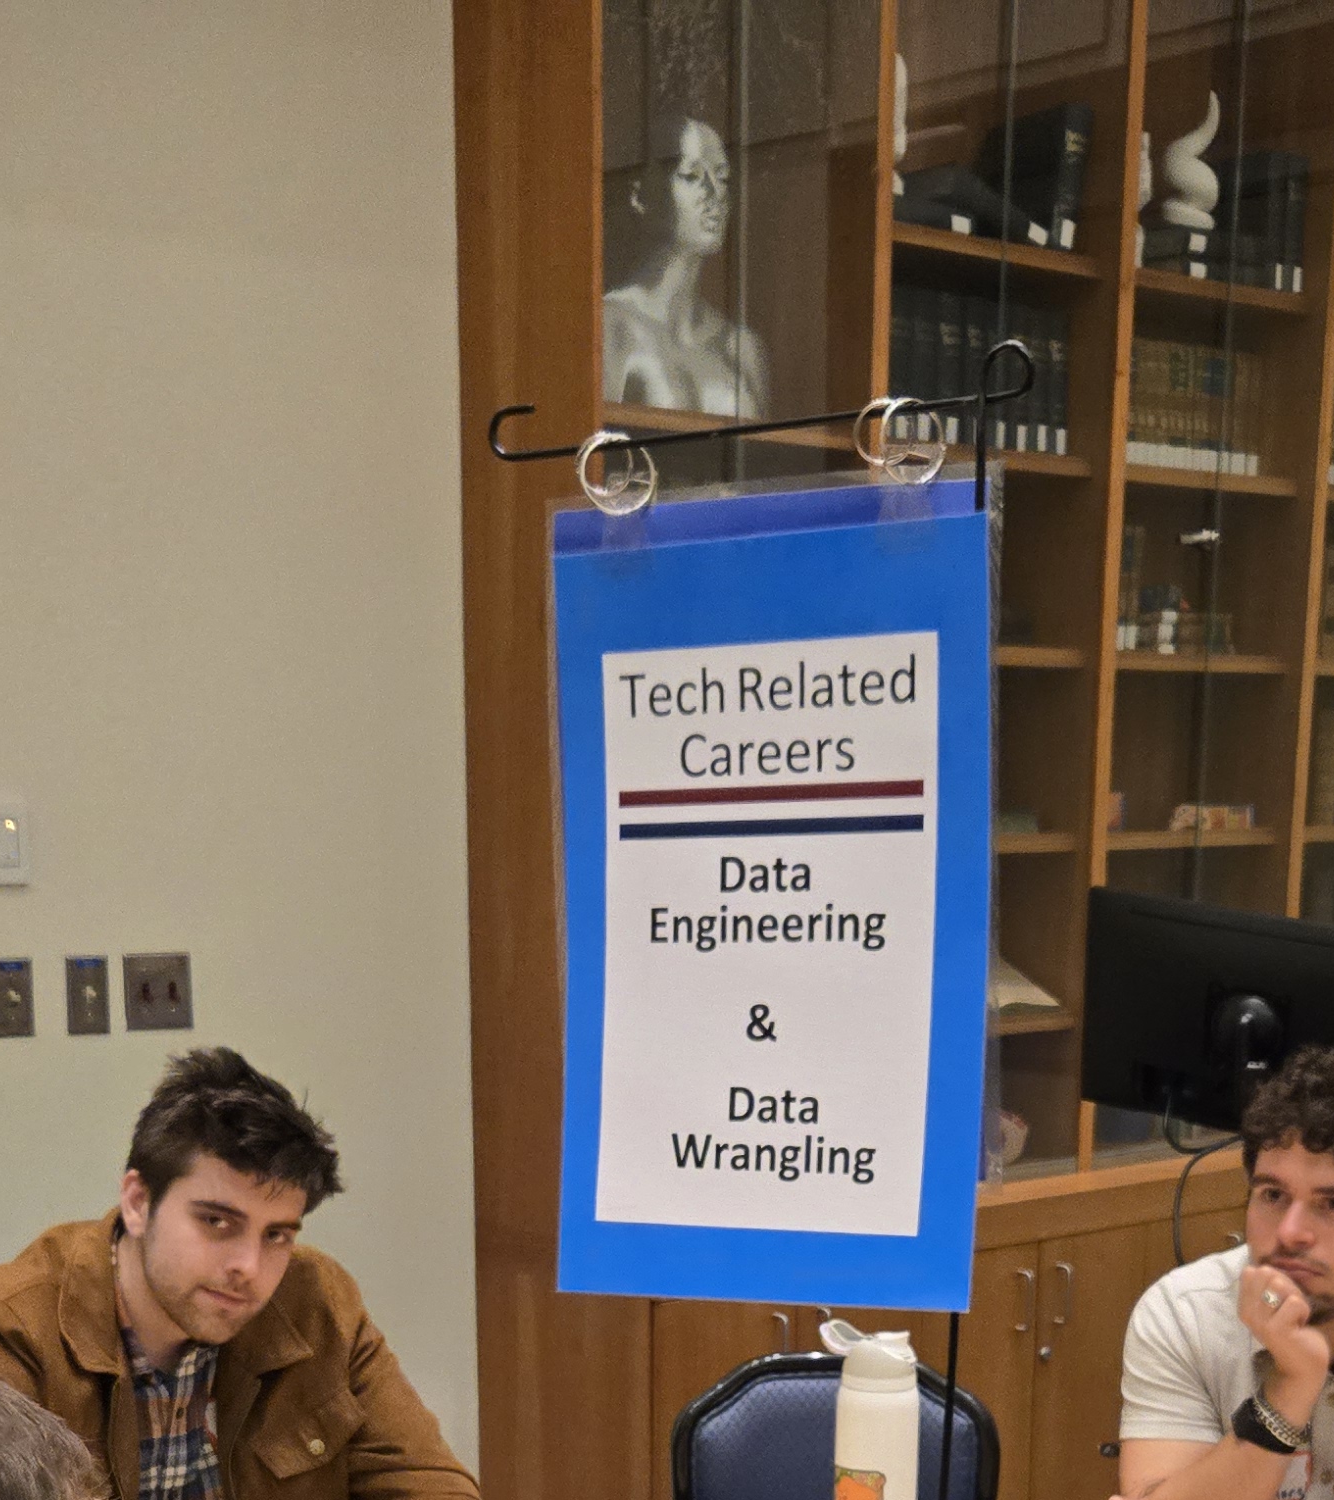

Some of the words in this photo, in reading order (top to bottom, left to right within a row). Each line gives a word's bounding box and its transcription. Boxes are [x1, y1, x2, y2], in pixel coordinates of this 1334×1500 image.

[619, 666, 725, 719] Tech
[738, 653, 916, 713] Related
[680, 733, 855, 778] Careers
[719, 856, 811, 893] Data
[650, 903, 887, 953] Engineering
[746, 1003, 777, 1042] &
[728, 1086, 819, 1125] Data
[671, 1132, 877, 1185] Wrangling
